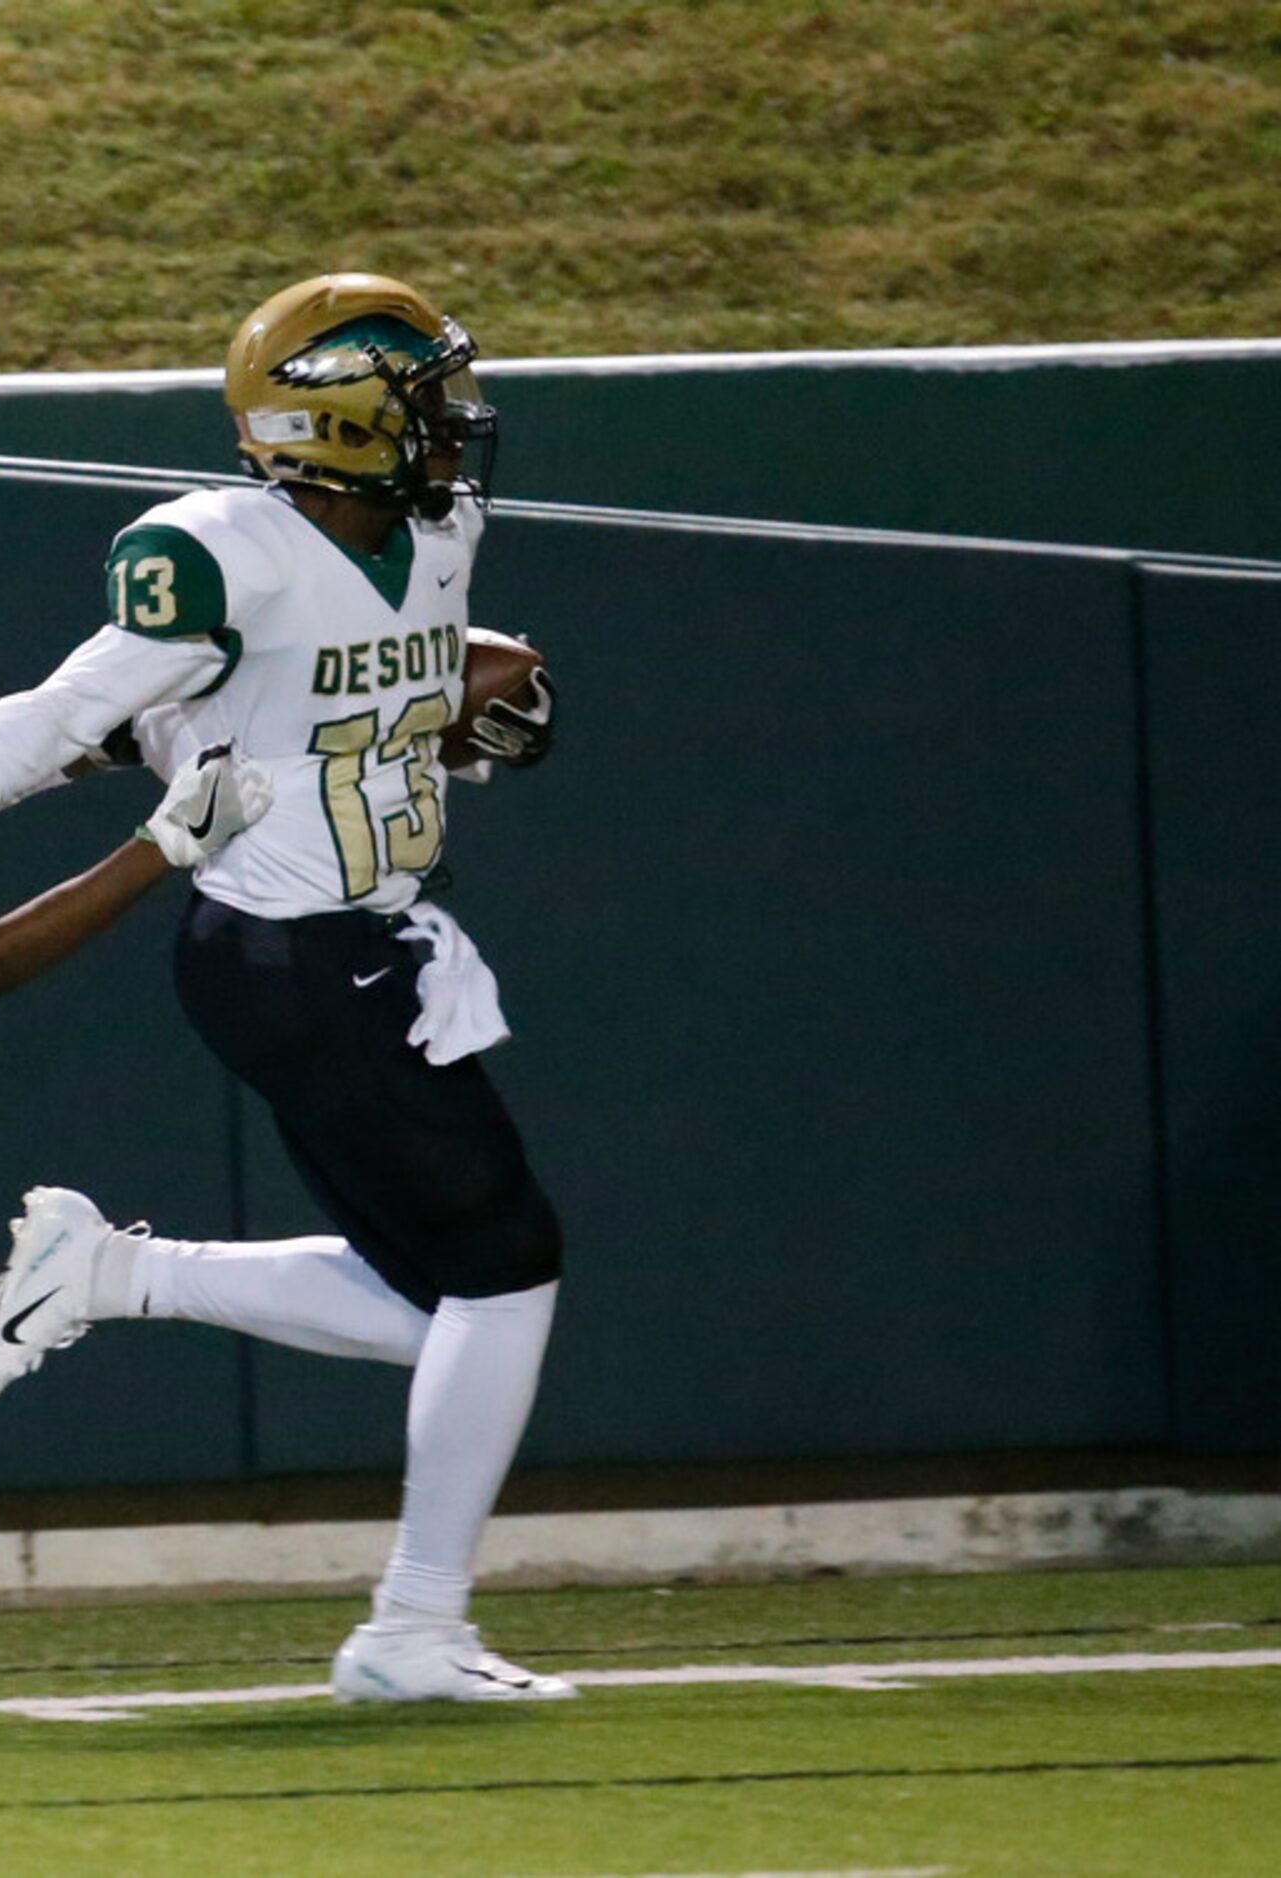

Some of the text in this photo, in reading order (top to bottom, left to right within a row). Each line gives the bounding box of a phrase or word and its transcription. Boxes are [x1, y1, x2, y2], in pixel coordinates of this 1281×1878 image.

[113, 555, 177, 627] 13
[310, 623, 460, 696] DESOTO
[306, 688, 452, 900] 13
